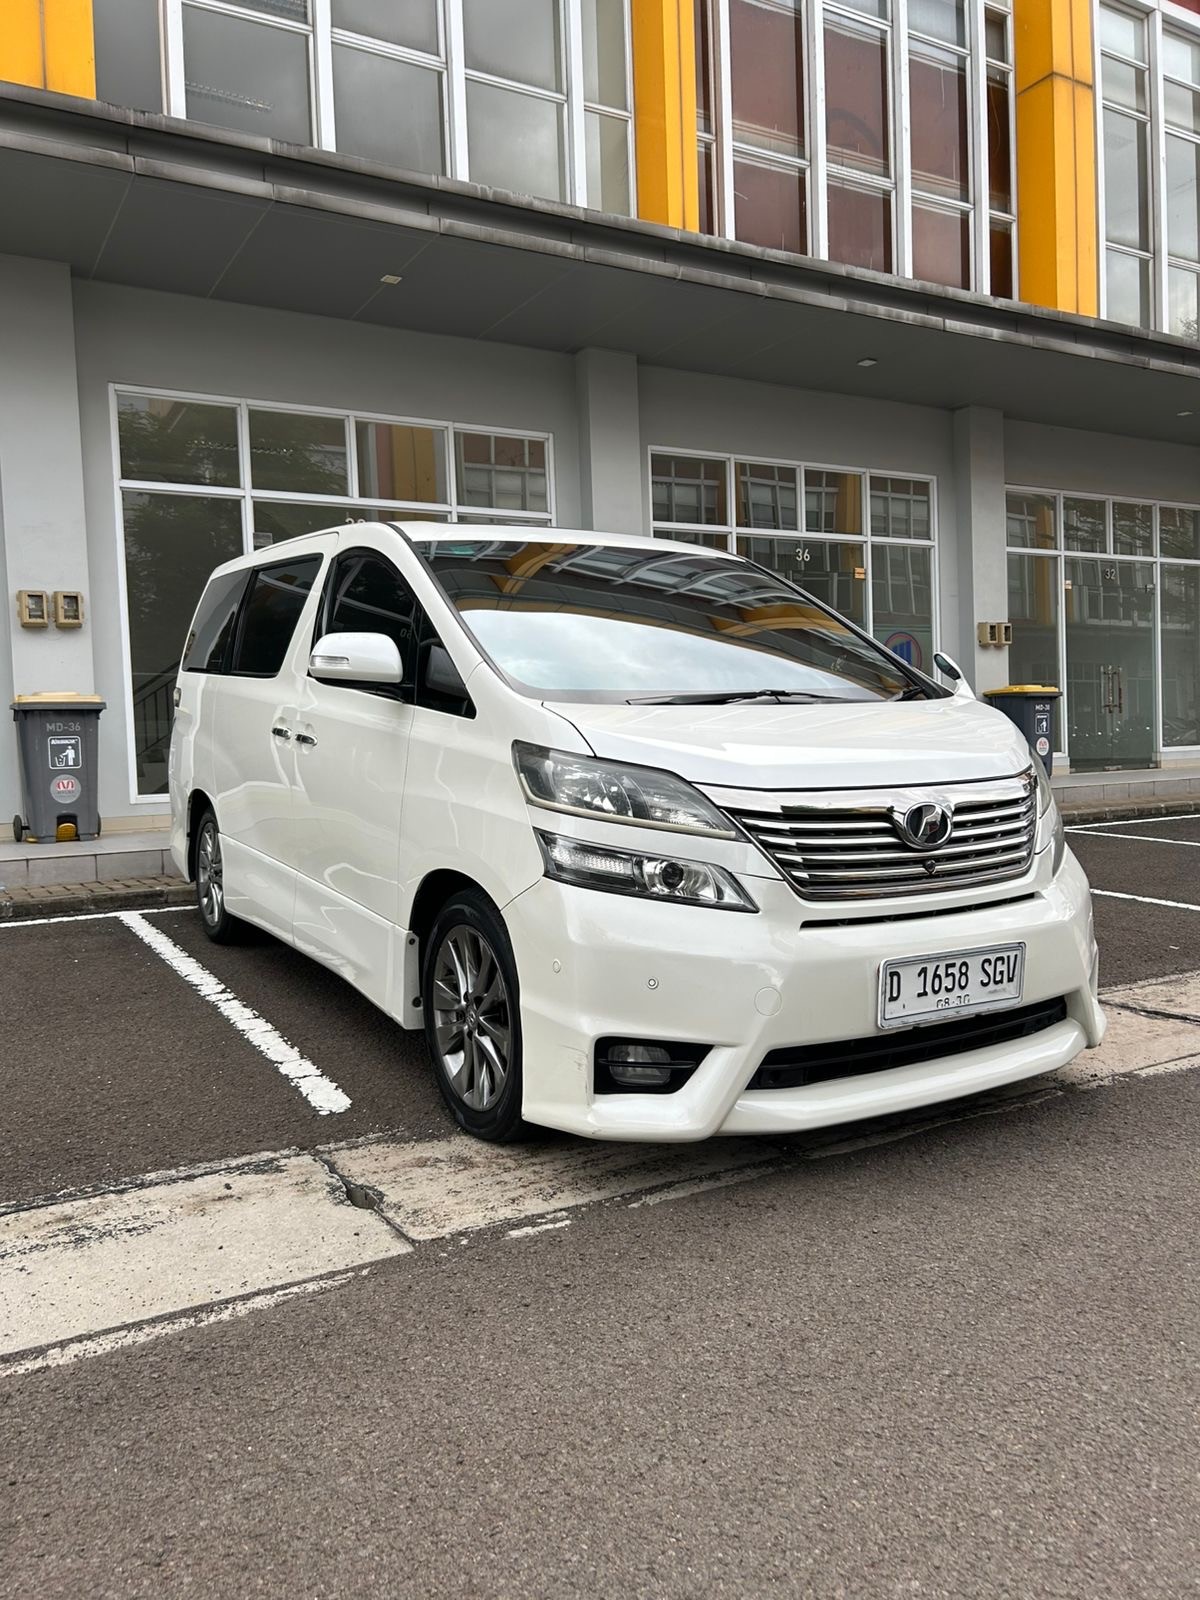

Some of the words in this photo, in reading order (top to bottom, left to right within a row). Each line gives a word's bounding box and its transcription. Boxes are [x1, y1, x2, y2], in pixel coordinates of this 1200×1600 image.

[796, 548, 810, 561] 36
[1105, 568, 1116, 580] 32
[46, 722, 81, 732] MD-36
[888, 970, 901, 1002] D
[917, 961, 969, 998] 1658
[980, 953, 1018, 987] SGV
